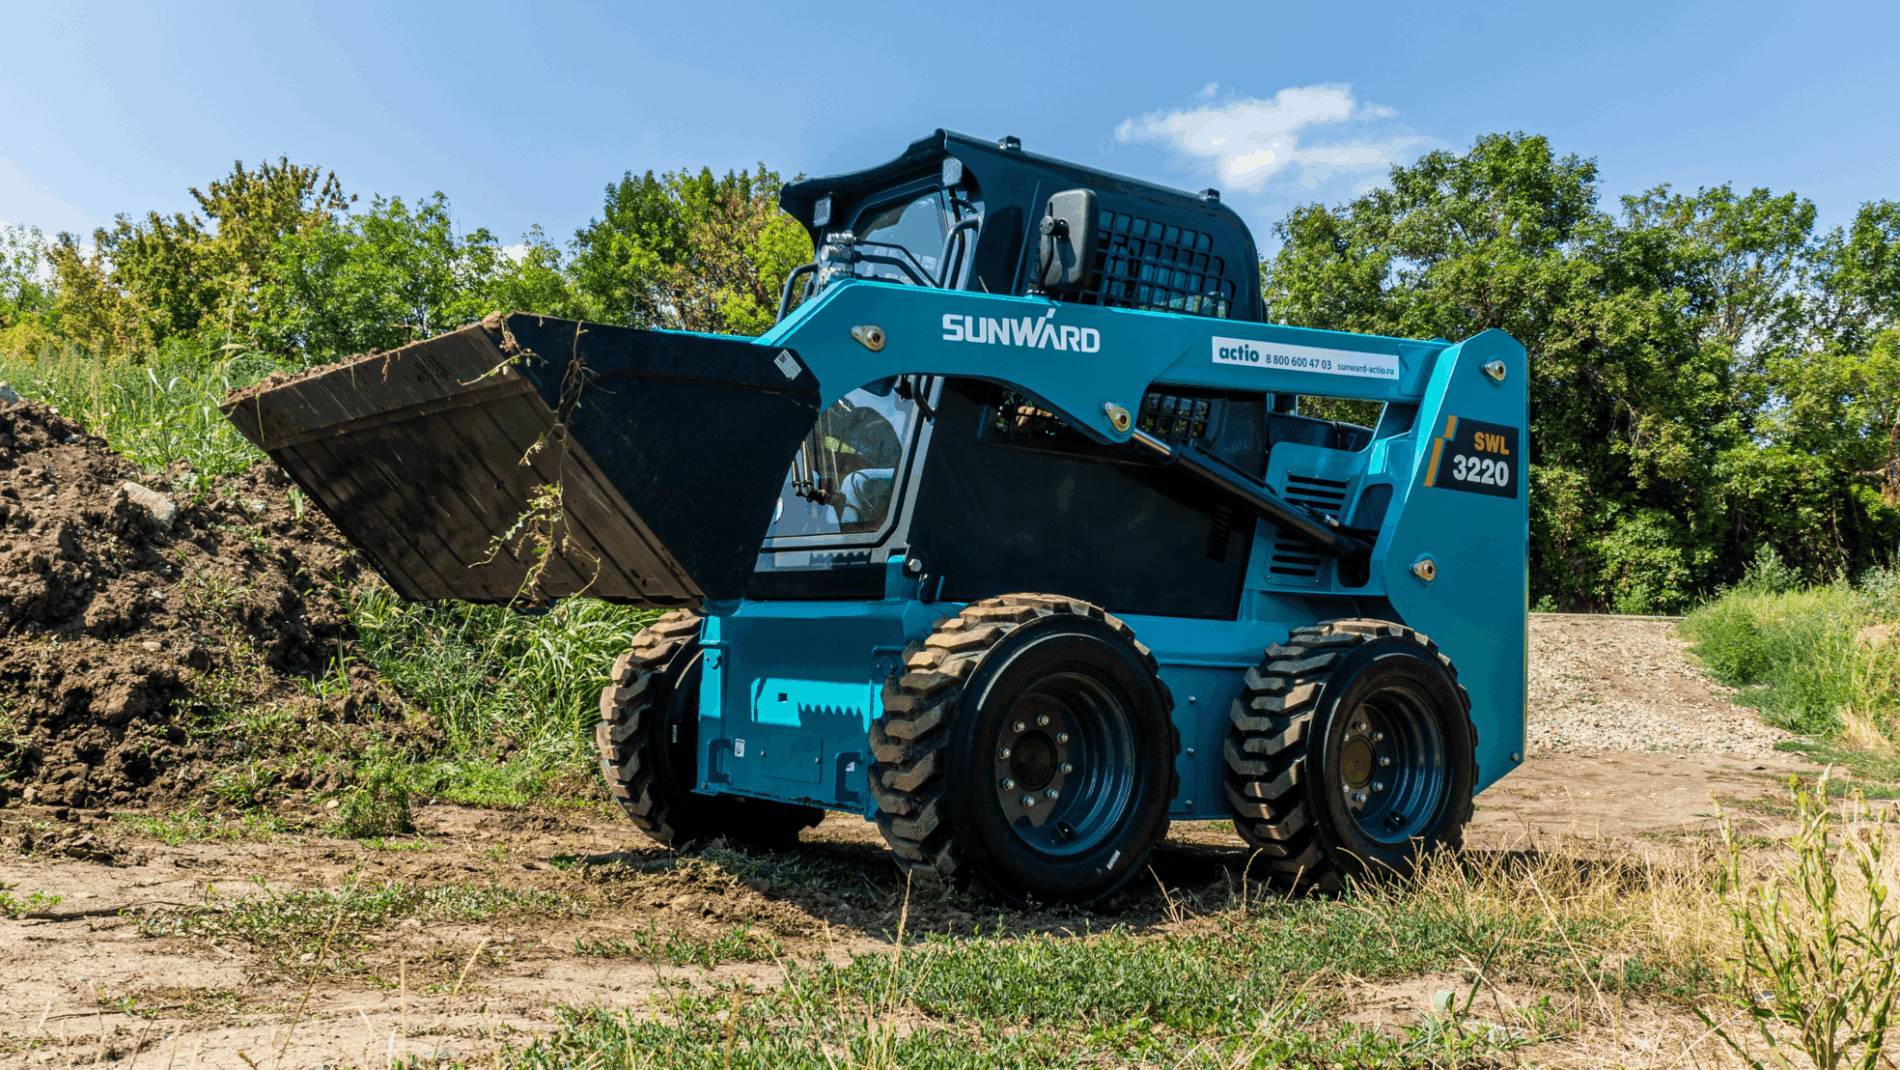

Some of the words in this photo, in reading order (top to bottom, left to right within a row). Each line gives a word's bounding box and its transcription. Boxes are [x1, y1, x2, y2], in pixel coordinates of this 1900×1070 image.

[942, 308, 1100, 353] SUNWARD
[1219, 344, 1260, 362] actio
[1266, 353, 1271, 364] 8
[1273, 354, 1290, 366] 800
[1291, 356, 1308, 368] 600
[1309, 358, 1320, 369] 47
[1321, 359, 1332, 370] 03
[1337, 363, 1394, 375] sunward-actio.ru
[1474, 431, 1510, 456] SWL
[1453, 454, 1509, 487] 3220
